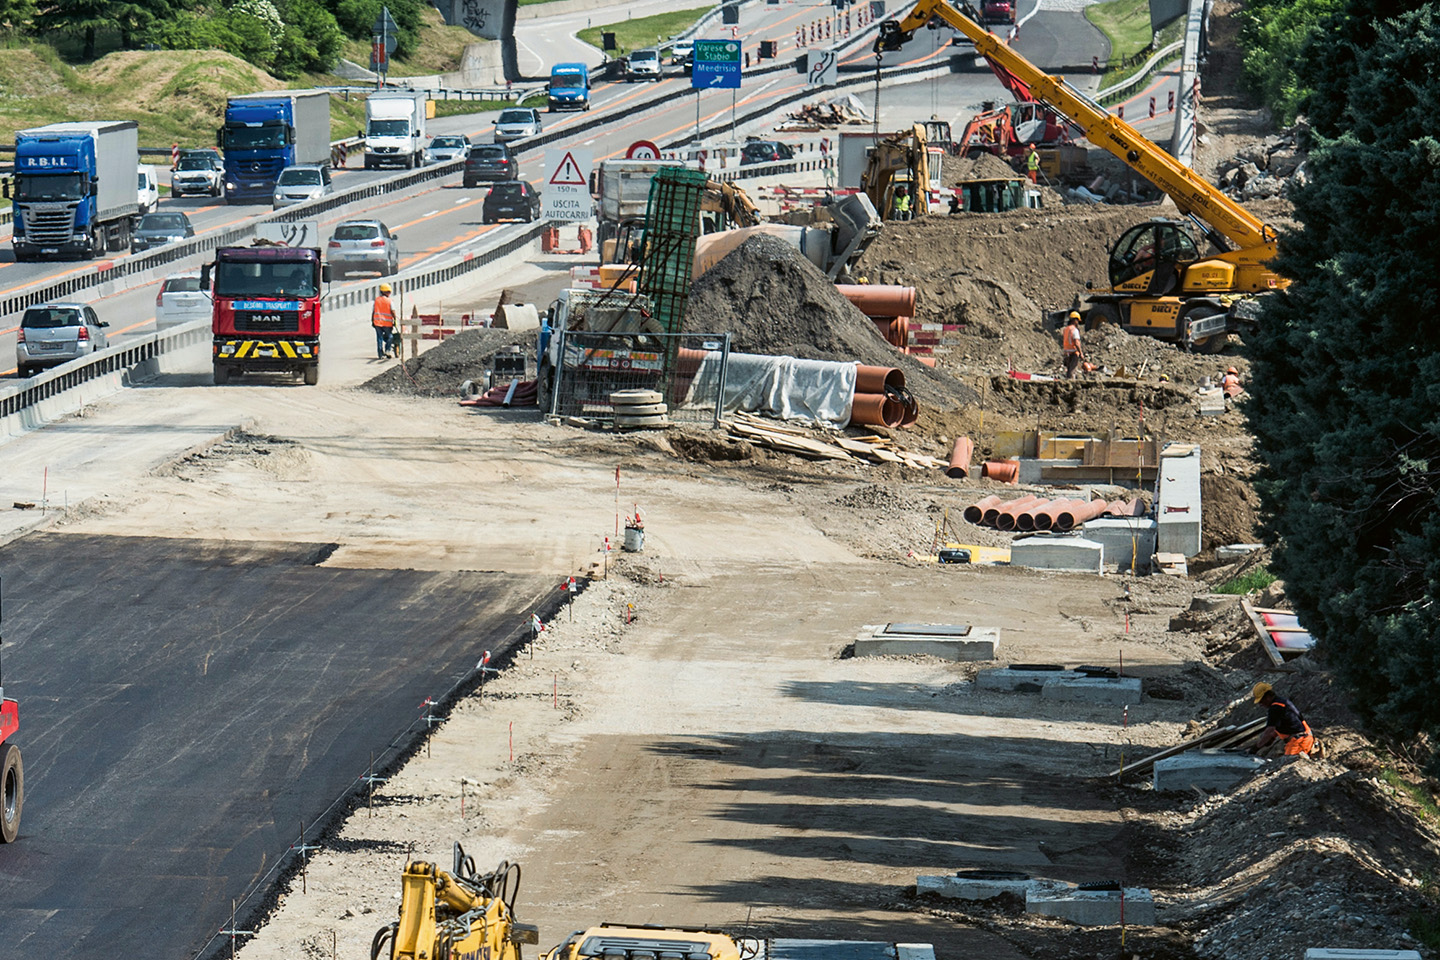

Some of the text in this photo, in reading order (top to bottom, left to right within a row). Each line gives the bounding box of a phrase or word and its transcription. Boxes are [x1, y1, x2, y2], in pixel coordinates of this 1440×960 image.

[697, 43, 724, 52] Varese
[704, 52, 730, 60] Stabio
[697, 64, 737, 72] Mendrisio
[553, 200, 580, 208] USCITA
[545, 210, 589, 219] AUTOCARRI
